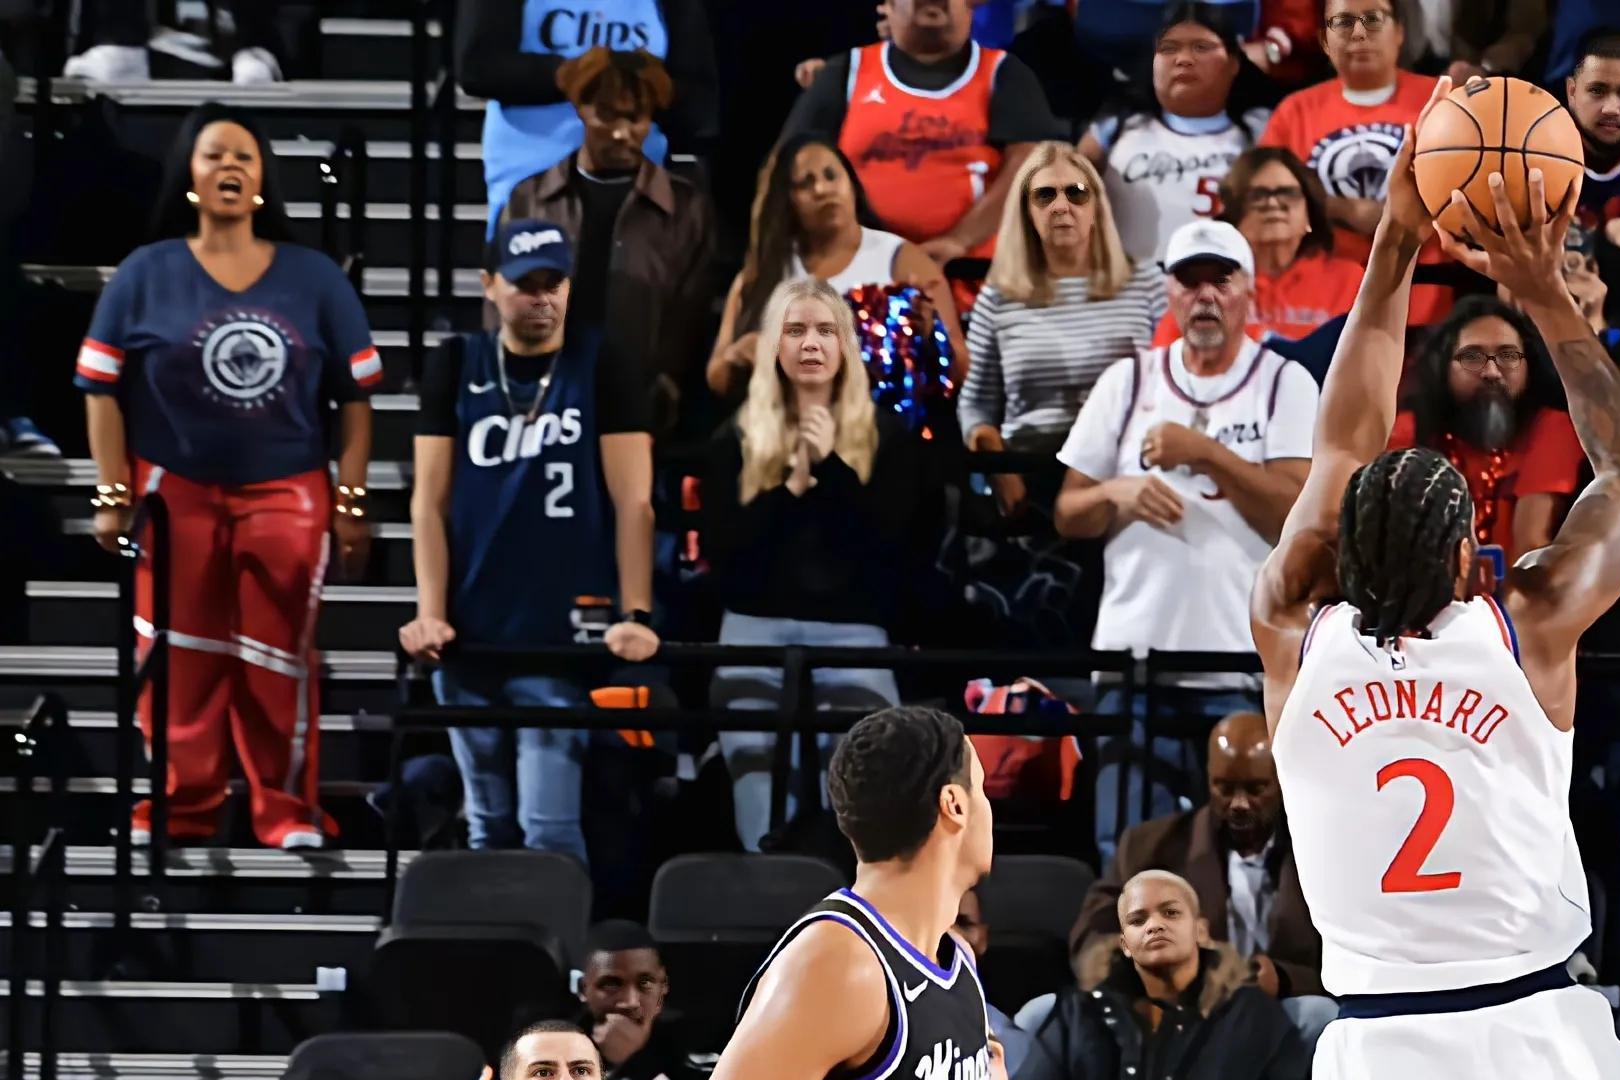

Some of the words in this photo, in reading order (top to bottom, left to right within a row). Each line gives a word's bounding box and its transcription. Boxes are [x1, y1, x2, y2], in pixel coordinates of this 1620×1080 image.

[539, 9, 649, 51] Clips
[467, 407, 583, 468] Clips
[544, 462, 575, 518] 2
[1312, 678, 1509, 748] LEONARD
[1376, 757, 1463, 894] 2
